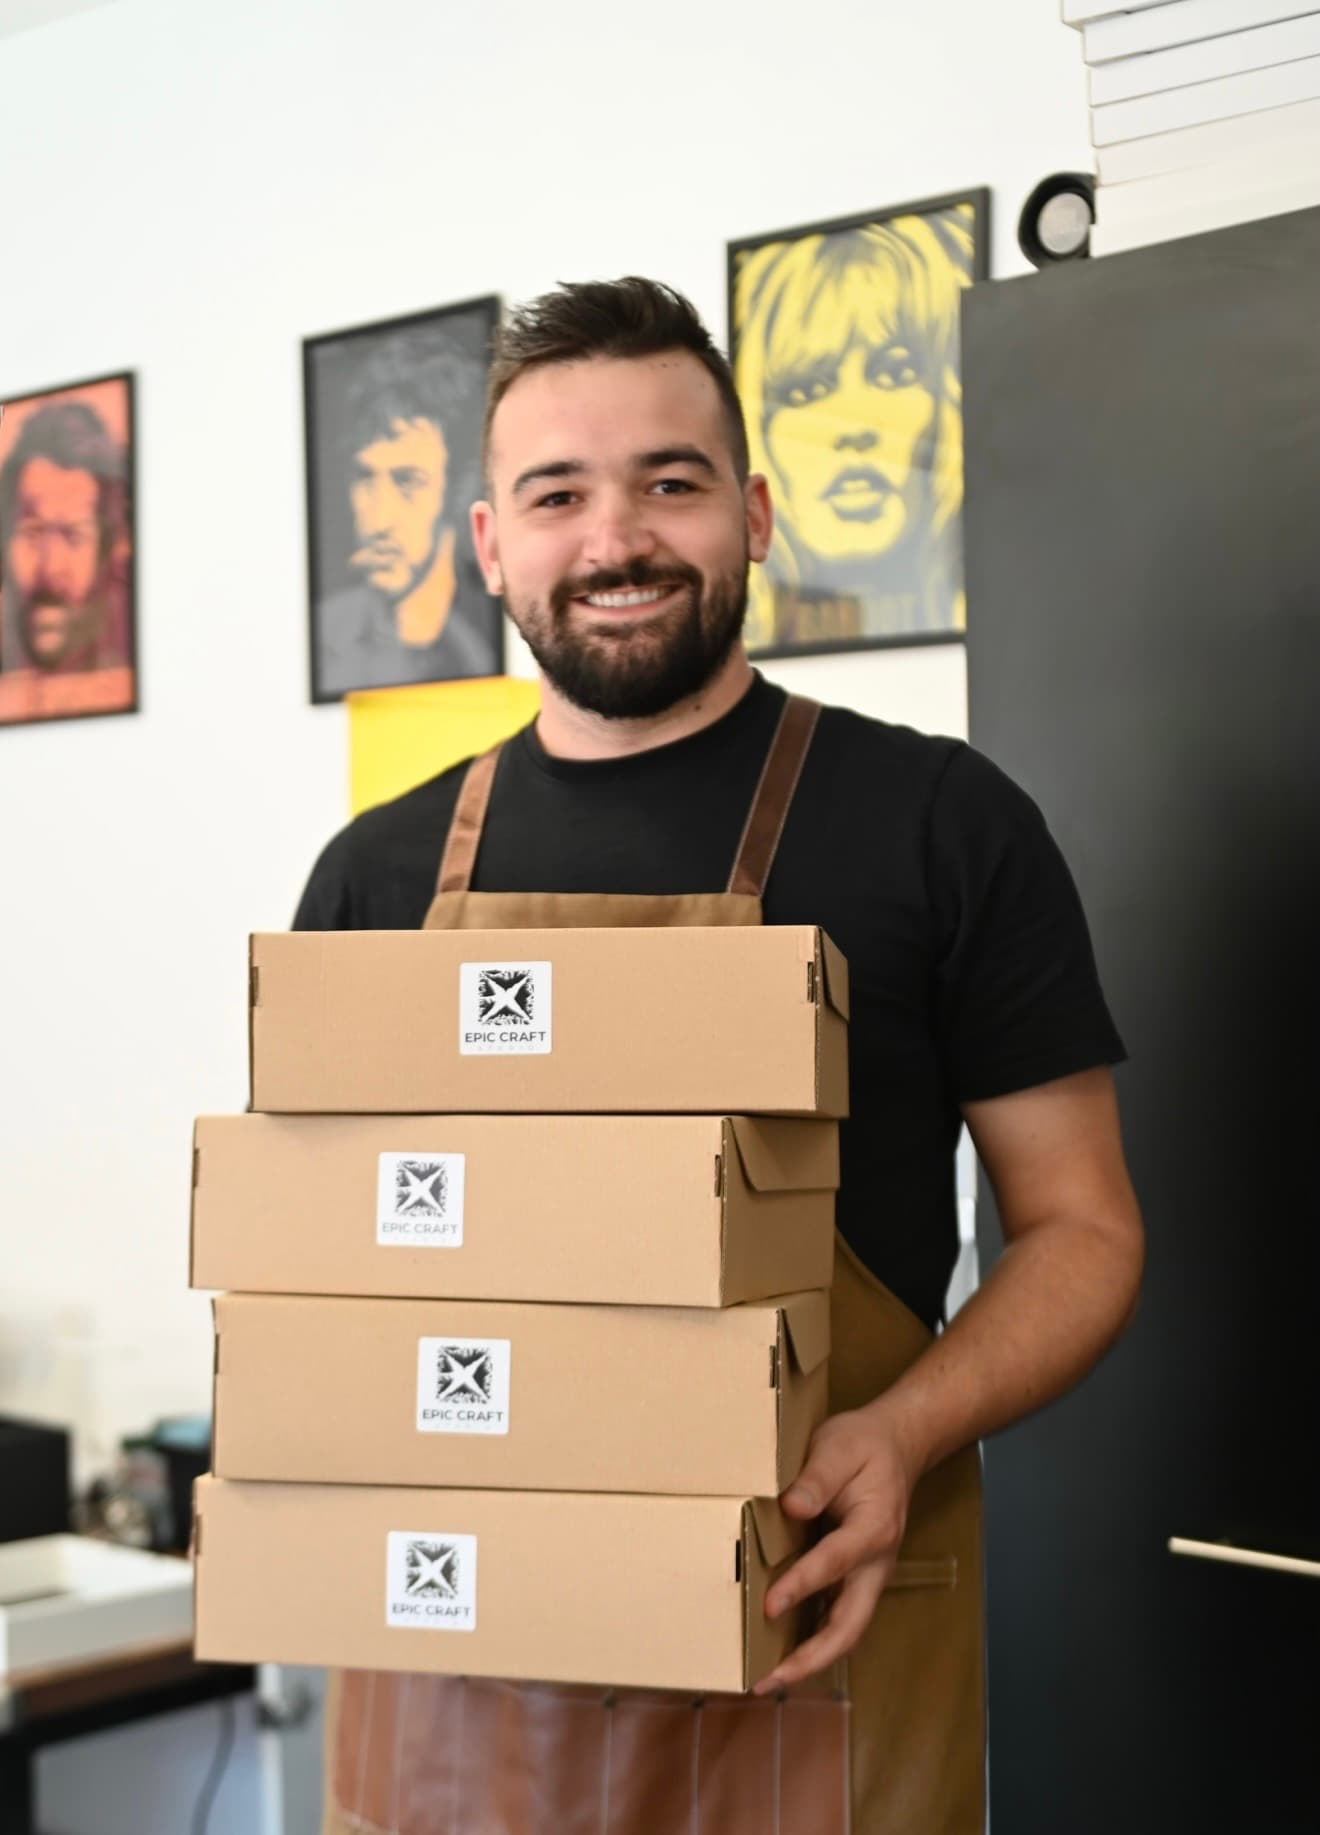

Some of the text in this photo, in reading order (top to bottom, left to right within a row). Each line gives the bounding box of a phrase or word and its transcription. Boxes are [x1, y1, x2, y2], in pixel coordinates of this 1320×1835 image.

[465, 1031, 546, 1043] EPIC CRAFT
[382, 1222, 460, 1234] EPIC CRAFT
[422, 1409, 504, 1422] EPIC CRAFT
[392, 1602, 471, 1617] EPIC CRAFT
